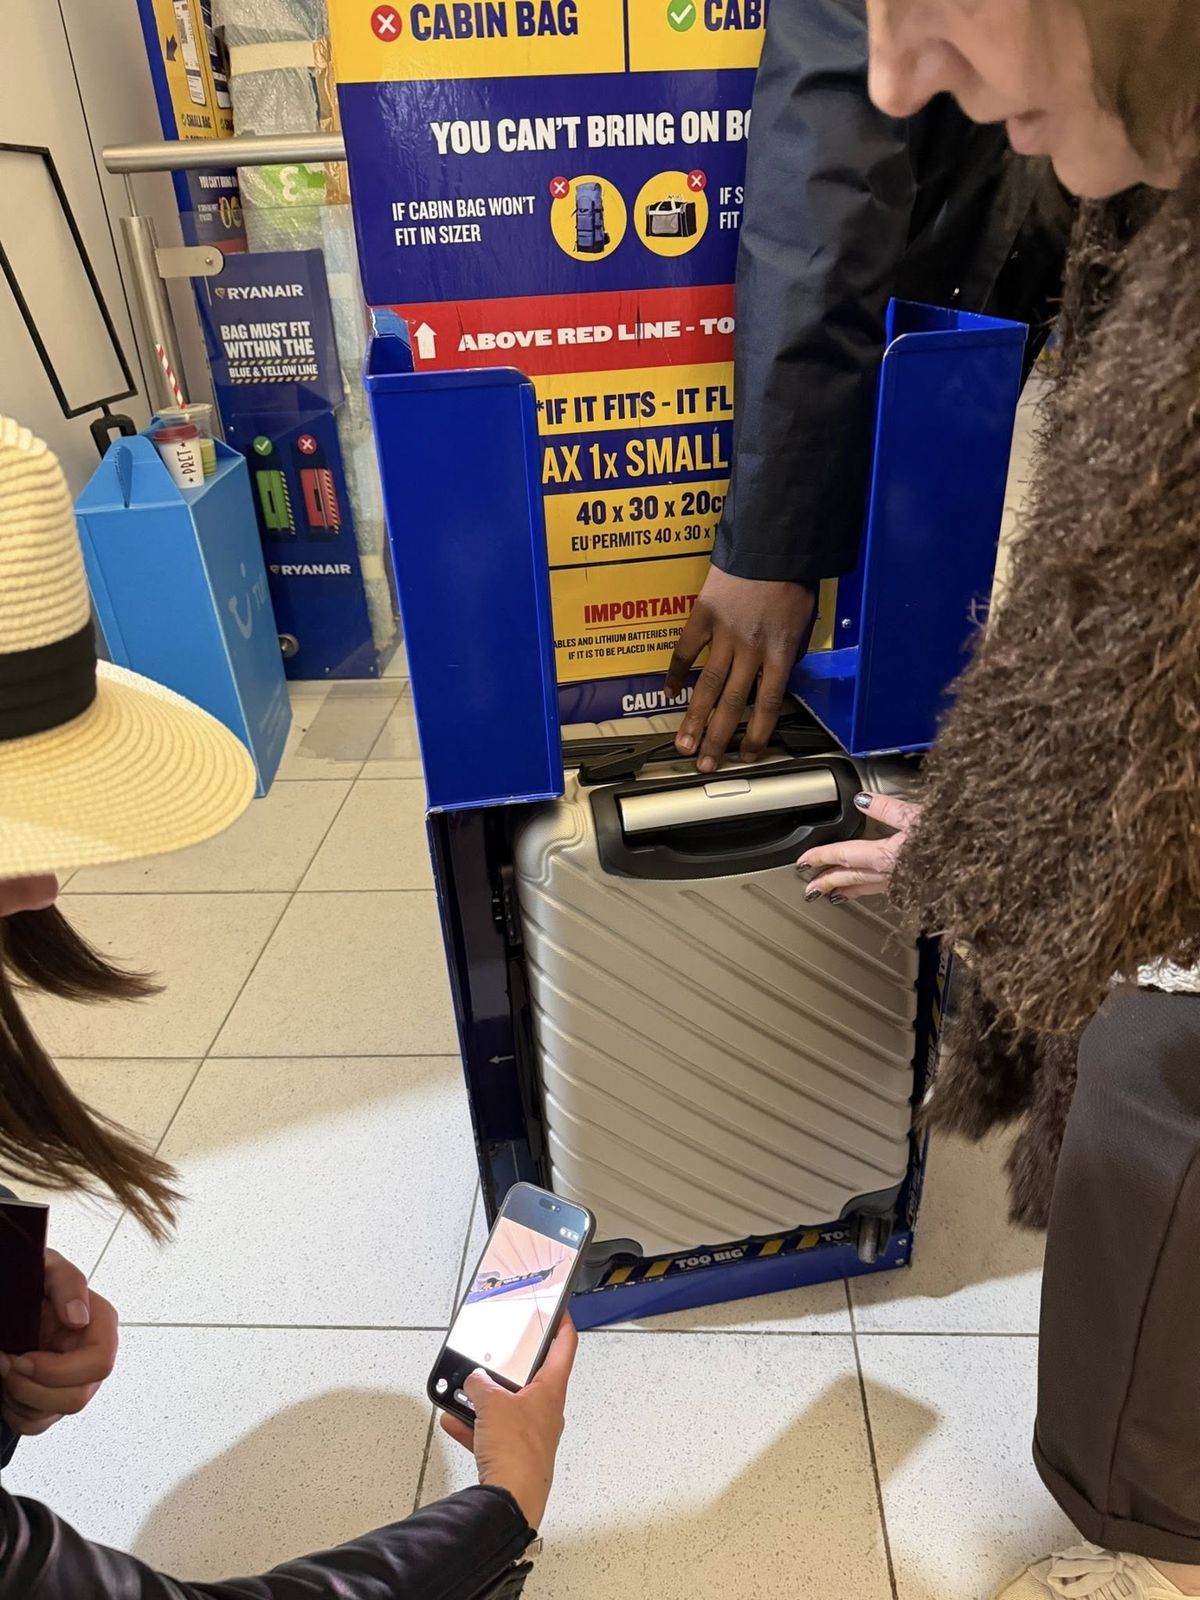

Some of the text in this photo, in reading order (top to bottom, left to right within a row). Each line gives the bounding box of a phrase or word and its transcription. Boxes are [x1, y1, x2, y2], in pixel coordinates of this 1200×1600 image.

[410, 0, 578, 41] CABIN BAG
[430, 120, 491, 155] YOU
[497, 116, 581, 152] CAN'T
[587, 112, 675, 148] BRING
[681, 110, 719, 144] ON
[719, 186, 733, 206] IF
[392, 196, 536, 221] IF CABIN BAG WON'T
[719, 211, 740, 230] FIT
[395, 223, 482, 246] FIT IN SIZER
[227, 284, 305, 300] RYANAIR
[220, 321, 311, 341] BAG MUST FIT
[458, 330, 551, 351] ABOVE
[557, 325, 613, 345] RED
[618, 320, 681, 341] LINE
[223, 338, 316, 360] WITHIN THE
[228, 363, 319, 379] BLUE & YELLOW LINE
[573, 396, 598, 423] IT
[603, 391, 656, 421] FITS
[676, 387, 700, 415] IT
[589, 443, 619, 480] 1x
[625, 432, 729, 478] SMALL
[576, 500, 606, 526] 40
[612, 505, 624, 522] x
[629, 495, 658, 522] 30
[664, 501, 675, 518] x
[571, 536, 589, 551] EU
[592, 530, 651, 550] PERMITS
[654, 528, 671, 543] 40
[674, 531, 681, 541] x
[684, 525, 700, 541] 30
[703, 527, 711, 539] x
[281, 564, 352, 575] RYANAIR
[577, 635, 593, 647] AND
[594, 632, 627, 645] LITHIUM
[627, 628, 668, 641] BATTERIES
[568, 650, 576, 661] IF
[576, 650, 584, 660] IT
[585, 649, 594, 659] IS
[594, 648, 605, 658] TO
[605, 646, 617, 657] BE
[616, 642, 647, 656] PLACED
[646, 641, 656, 652] IN
[820, 1230, 850, 1242] TO
[675, 1248, 744, 1269] TOO BIG
